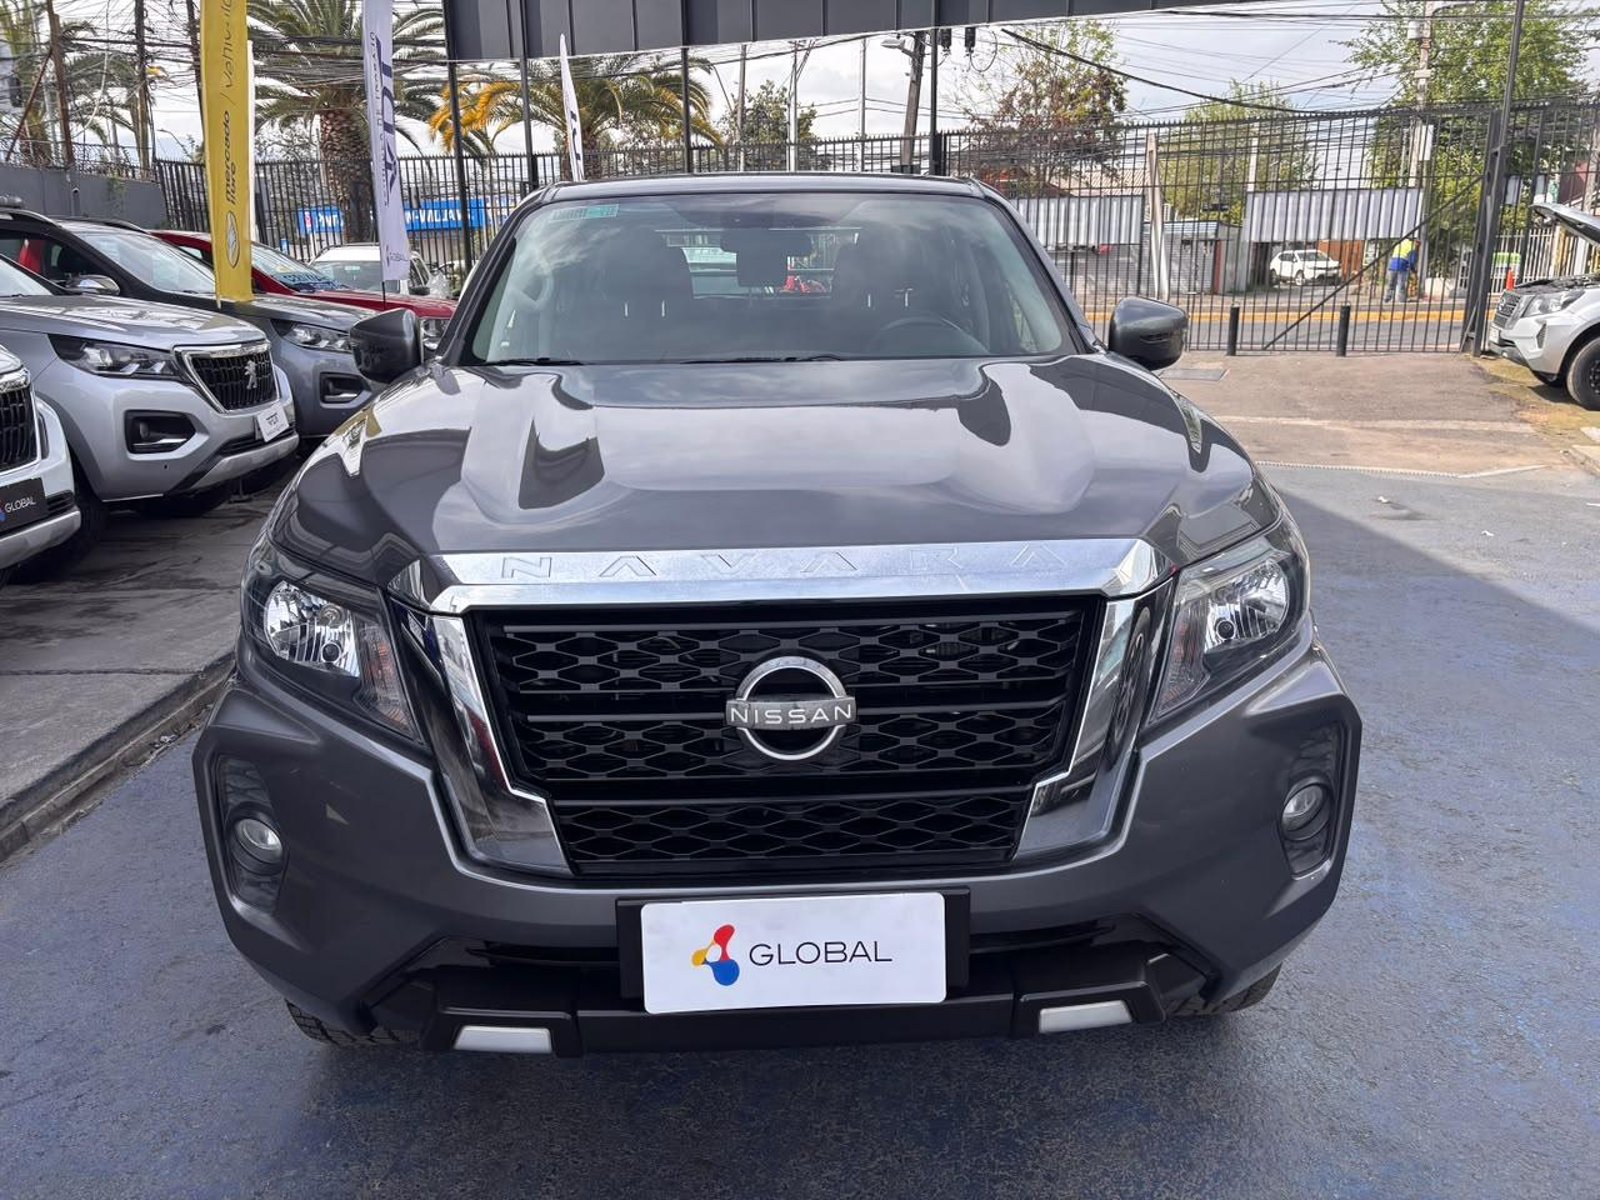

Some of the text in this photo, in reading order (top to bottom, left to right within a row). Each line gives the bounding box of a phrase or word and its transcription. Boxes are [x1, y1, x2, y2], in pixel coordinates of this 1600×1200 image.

[223, 110, 231, 202] mercado
[4, 496, 37, 513] GLOBAL
[500, 541, 1068, 578] NAVARA
[730, 703, 852, 725] NISSAN
[749, 940, 893, 966] GLOBAL
